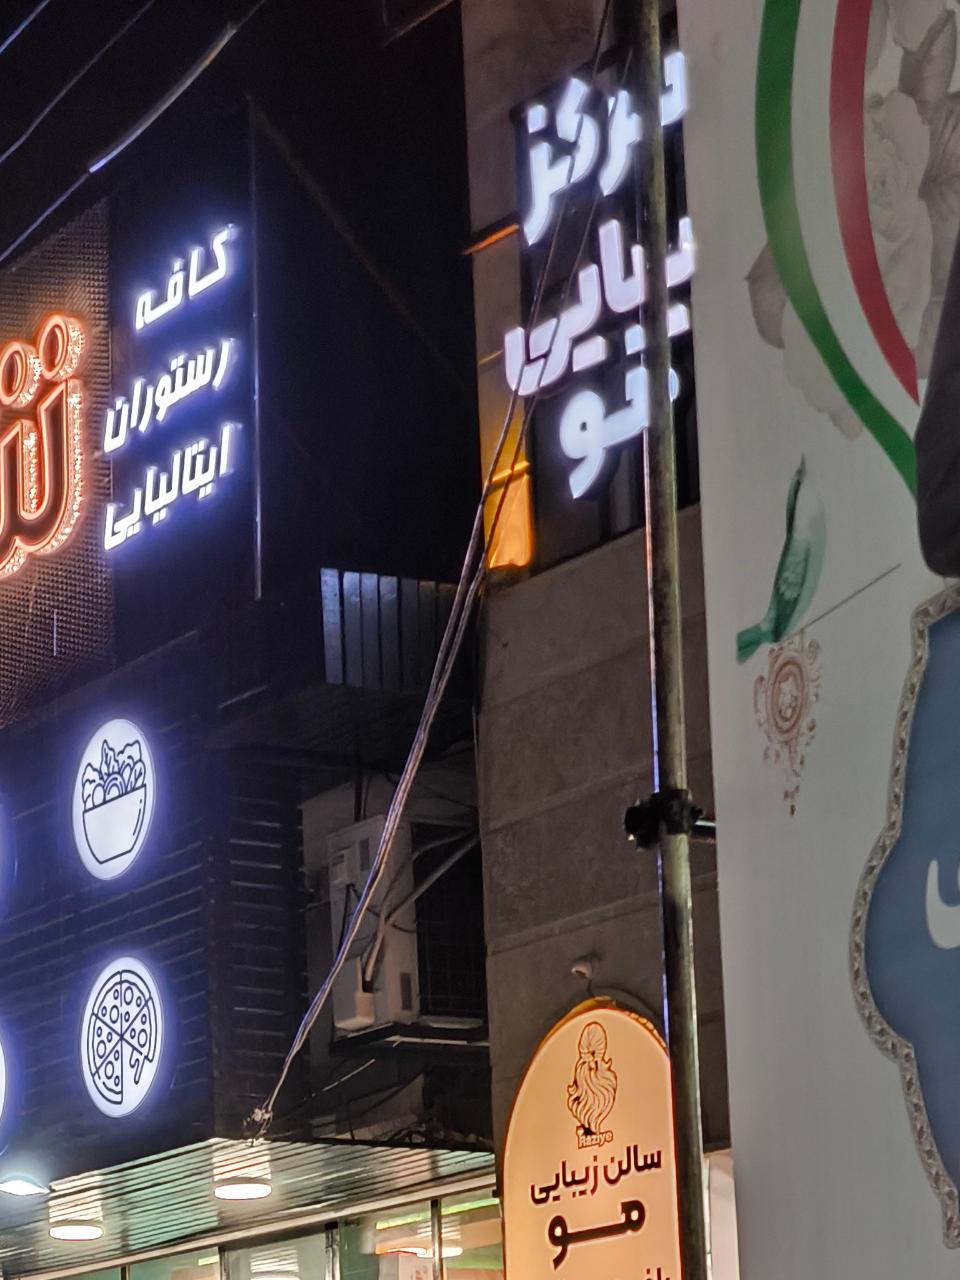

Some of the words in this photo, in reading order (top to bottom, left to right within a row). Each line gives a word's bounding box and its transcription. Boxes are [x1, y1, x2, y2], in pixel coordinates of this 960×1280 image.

[136, 224, 234, 331] کافه
[104, 338, 234, 453] رستوران
[104, 423, 237, 551] ایتالیایی
[577, 1126, 613, 1149] Raziye
[603, 1144, 662, 1185] سالن
[530, 1155, 598, 1205] زیبایی
[548, 1199, 646, 1271] مو
